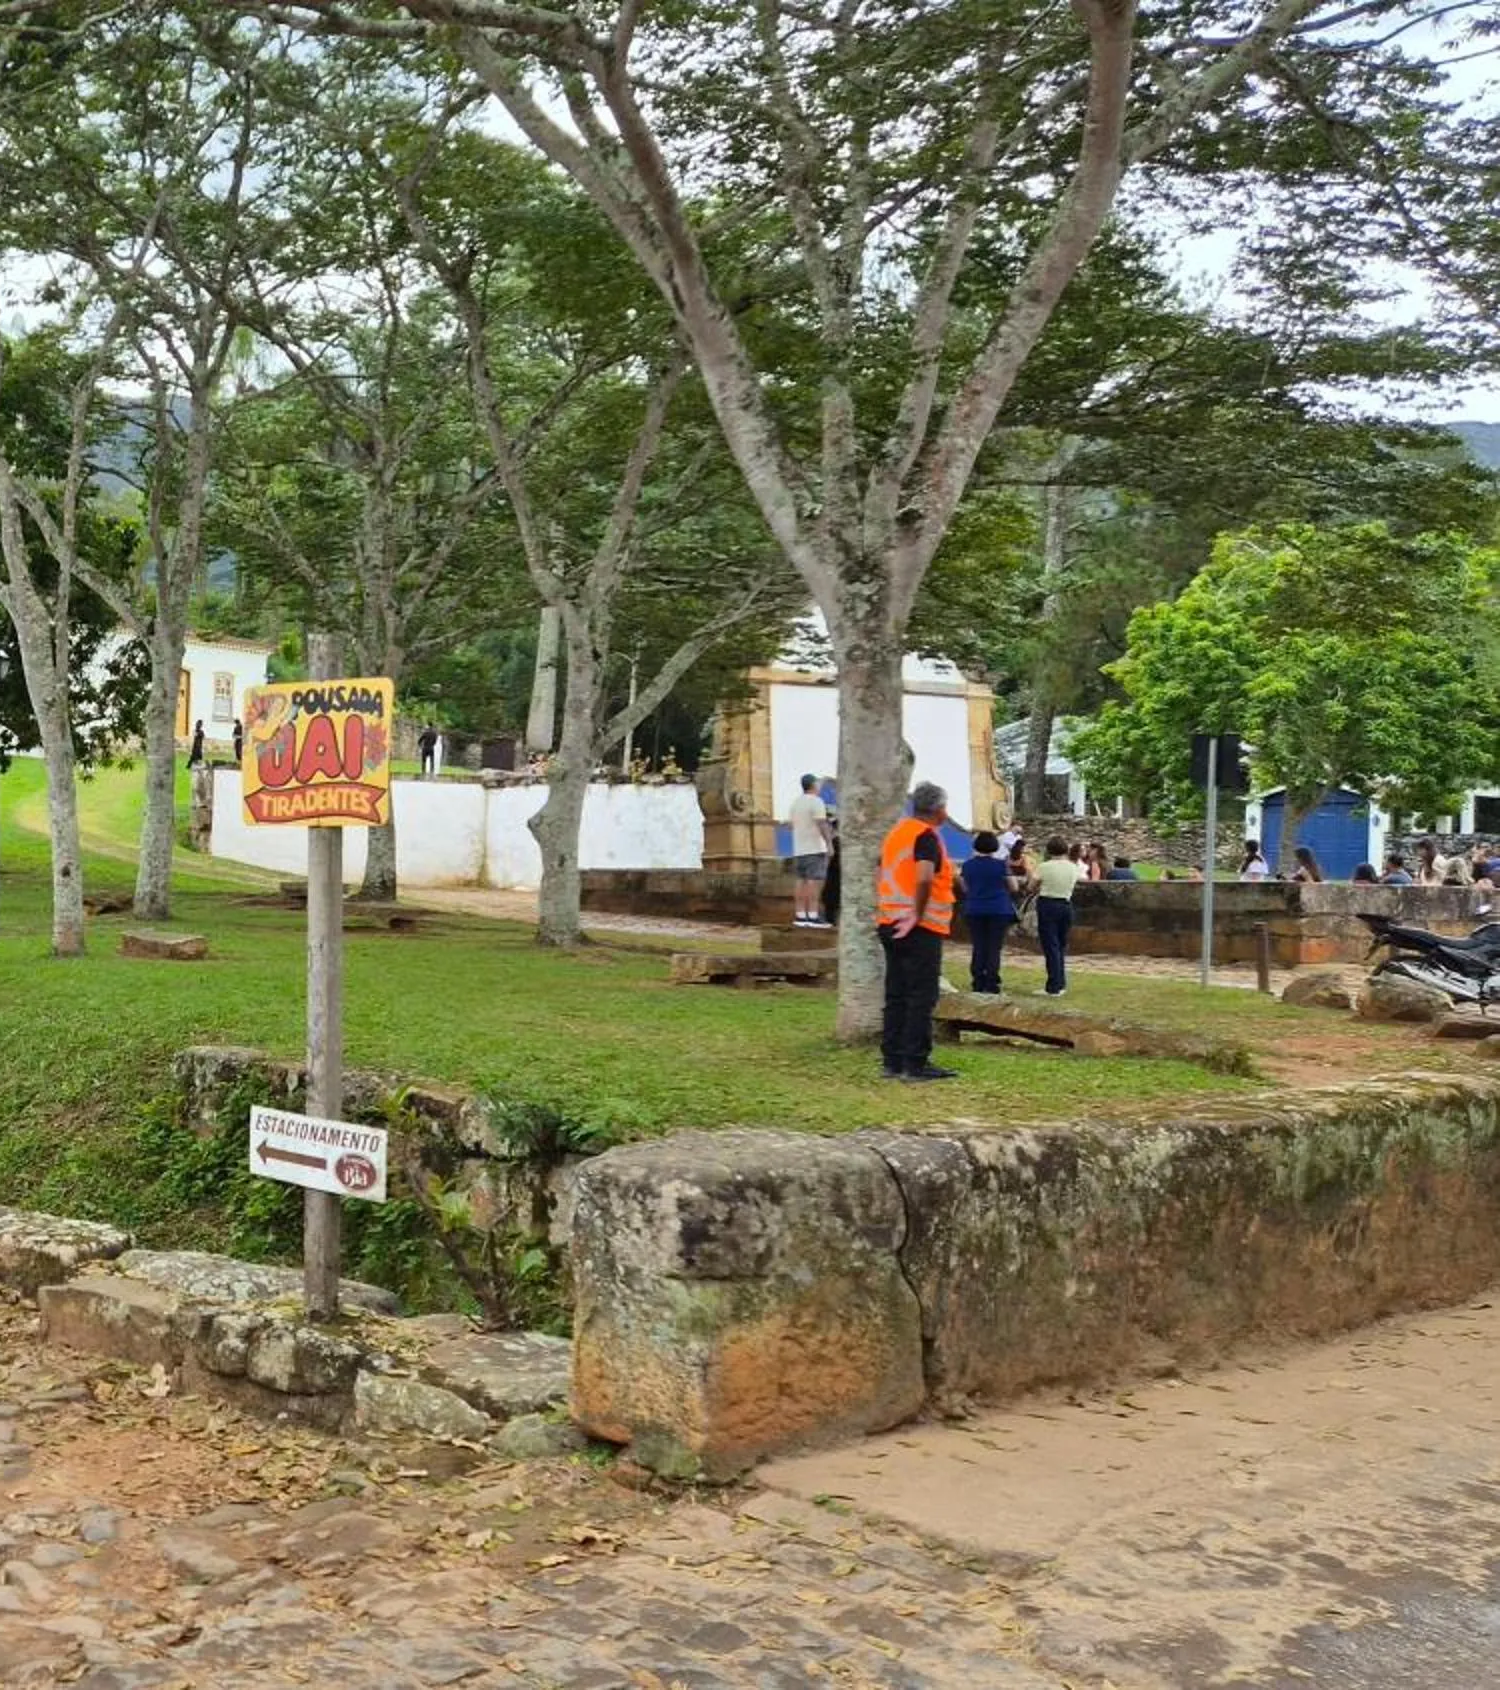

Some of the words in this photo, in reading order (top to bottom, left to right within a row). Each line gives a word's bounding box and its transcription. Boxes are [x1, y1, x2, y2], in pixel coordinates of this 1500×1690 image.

[291, 685, 384, 720] POUSADA
[260, 788, 372, 817] TIRADENTES
[255, 1114, 380, 1153] ESTACIONAMENTO
